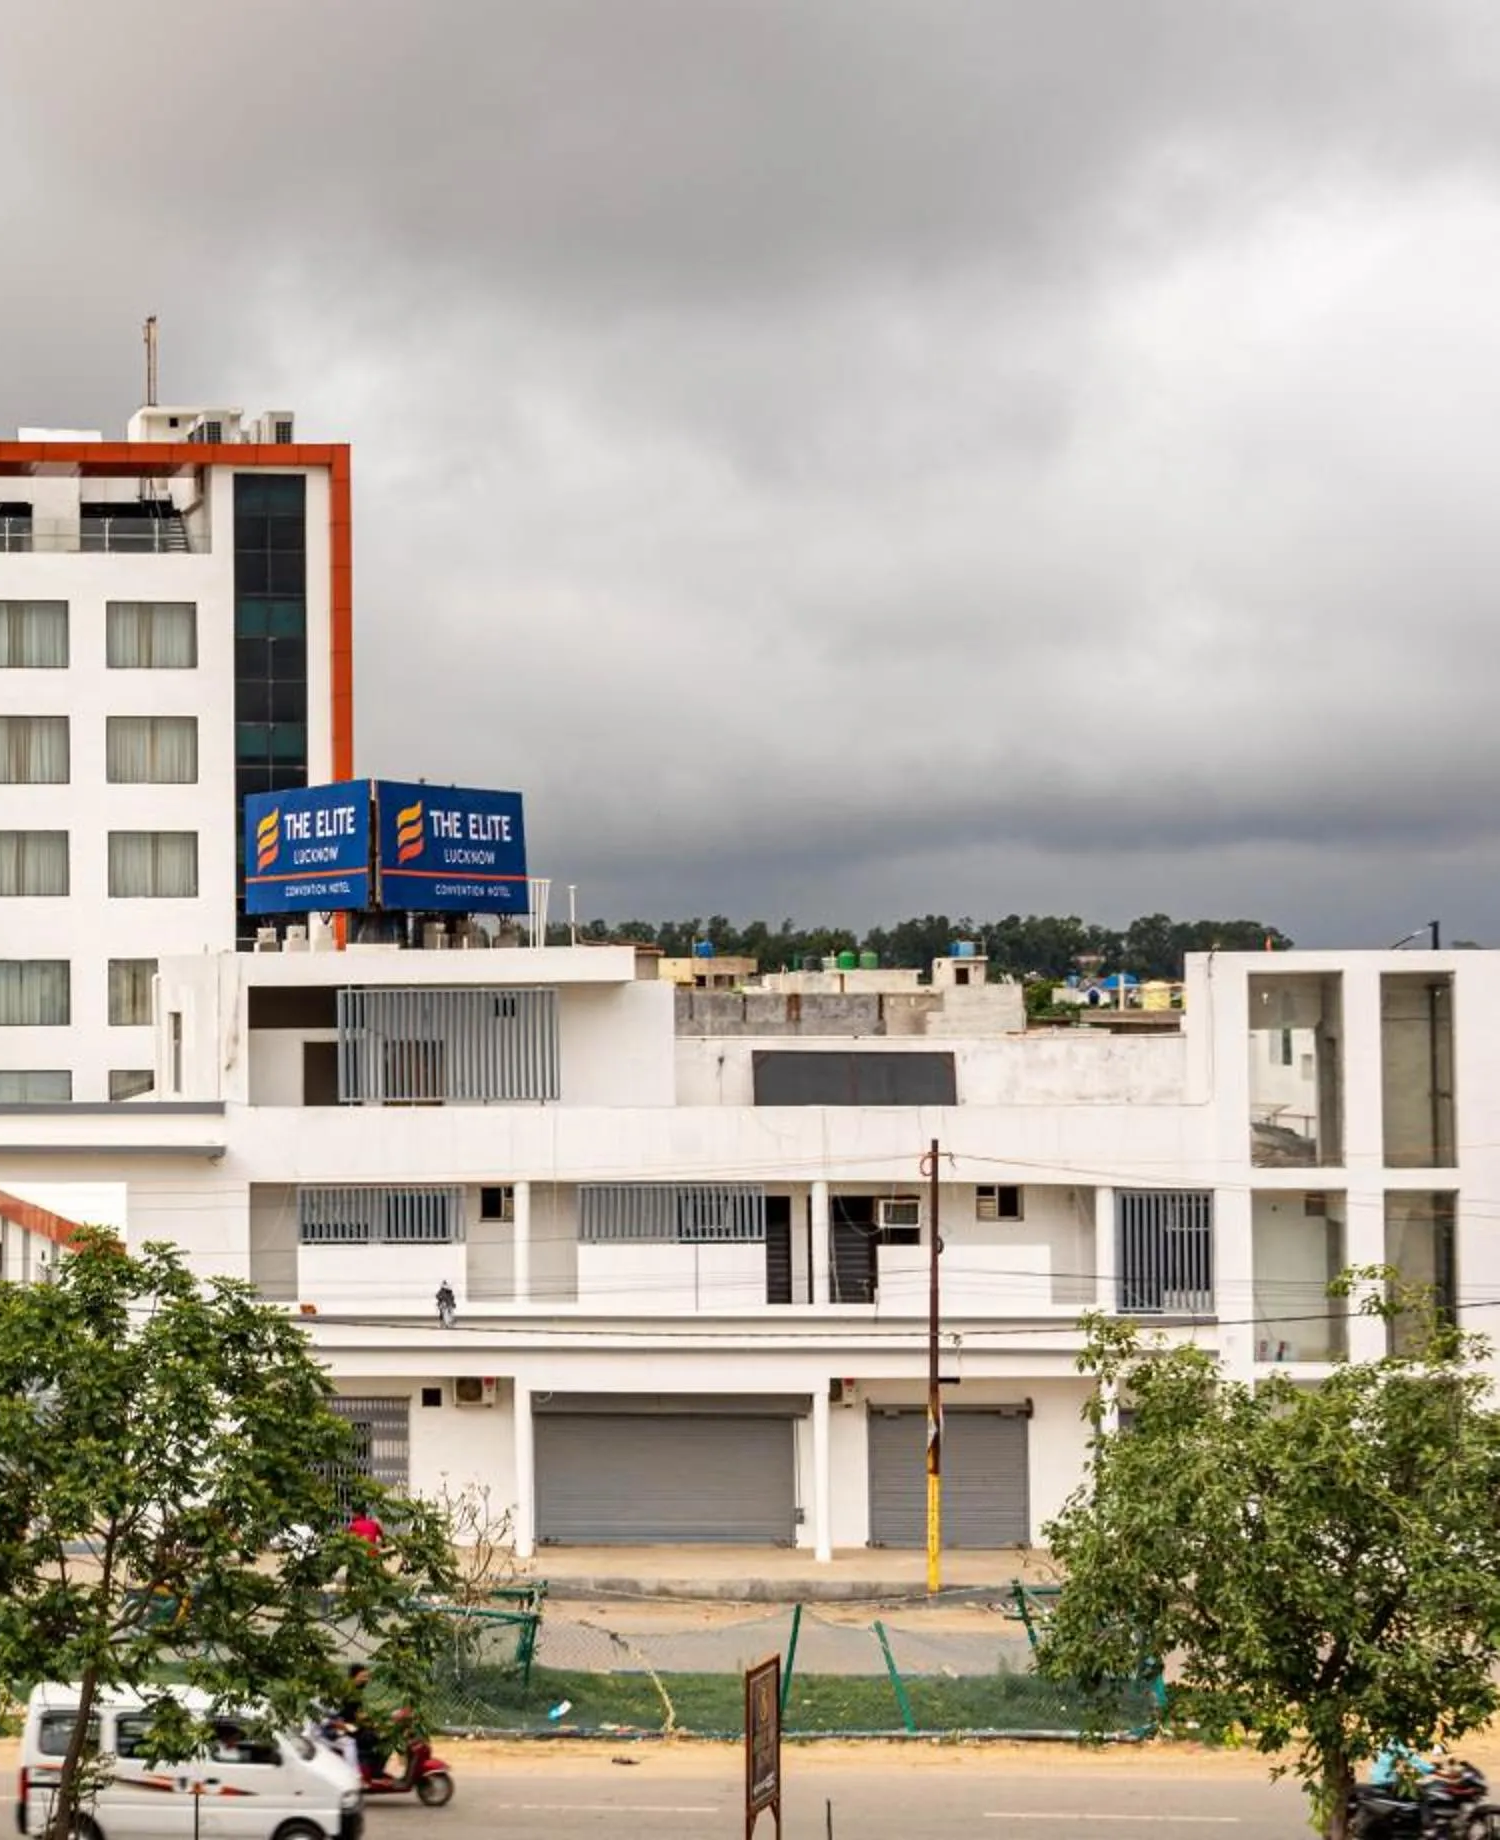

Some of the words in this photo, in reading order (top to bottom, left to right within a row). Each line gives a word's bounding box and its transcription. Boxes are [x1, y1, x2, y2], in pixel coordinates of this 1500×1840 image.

[284, 811, 311, 841] THE
[315, 806, 356, 837] ELITE
[429, 810, 462, 838] THE
[469, 812, 512, 842] ELITE
[293, 846, 339, 865] LUCKNOW
[444, 849, 496, 865] LUCKNOW
